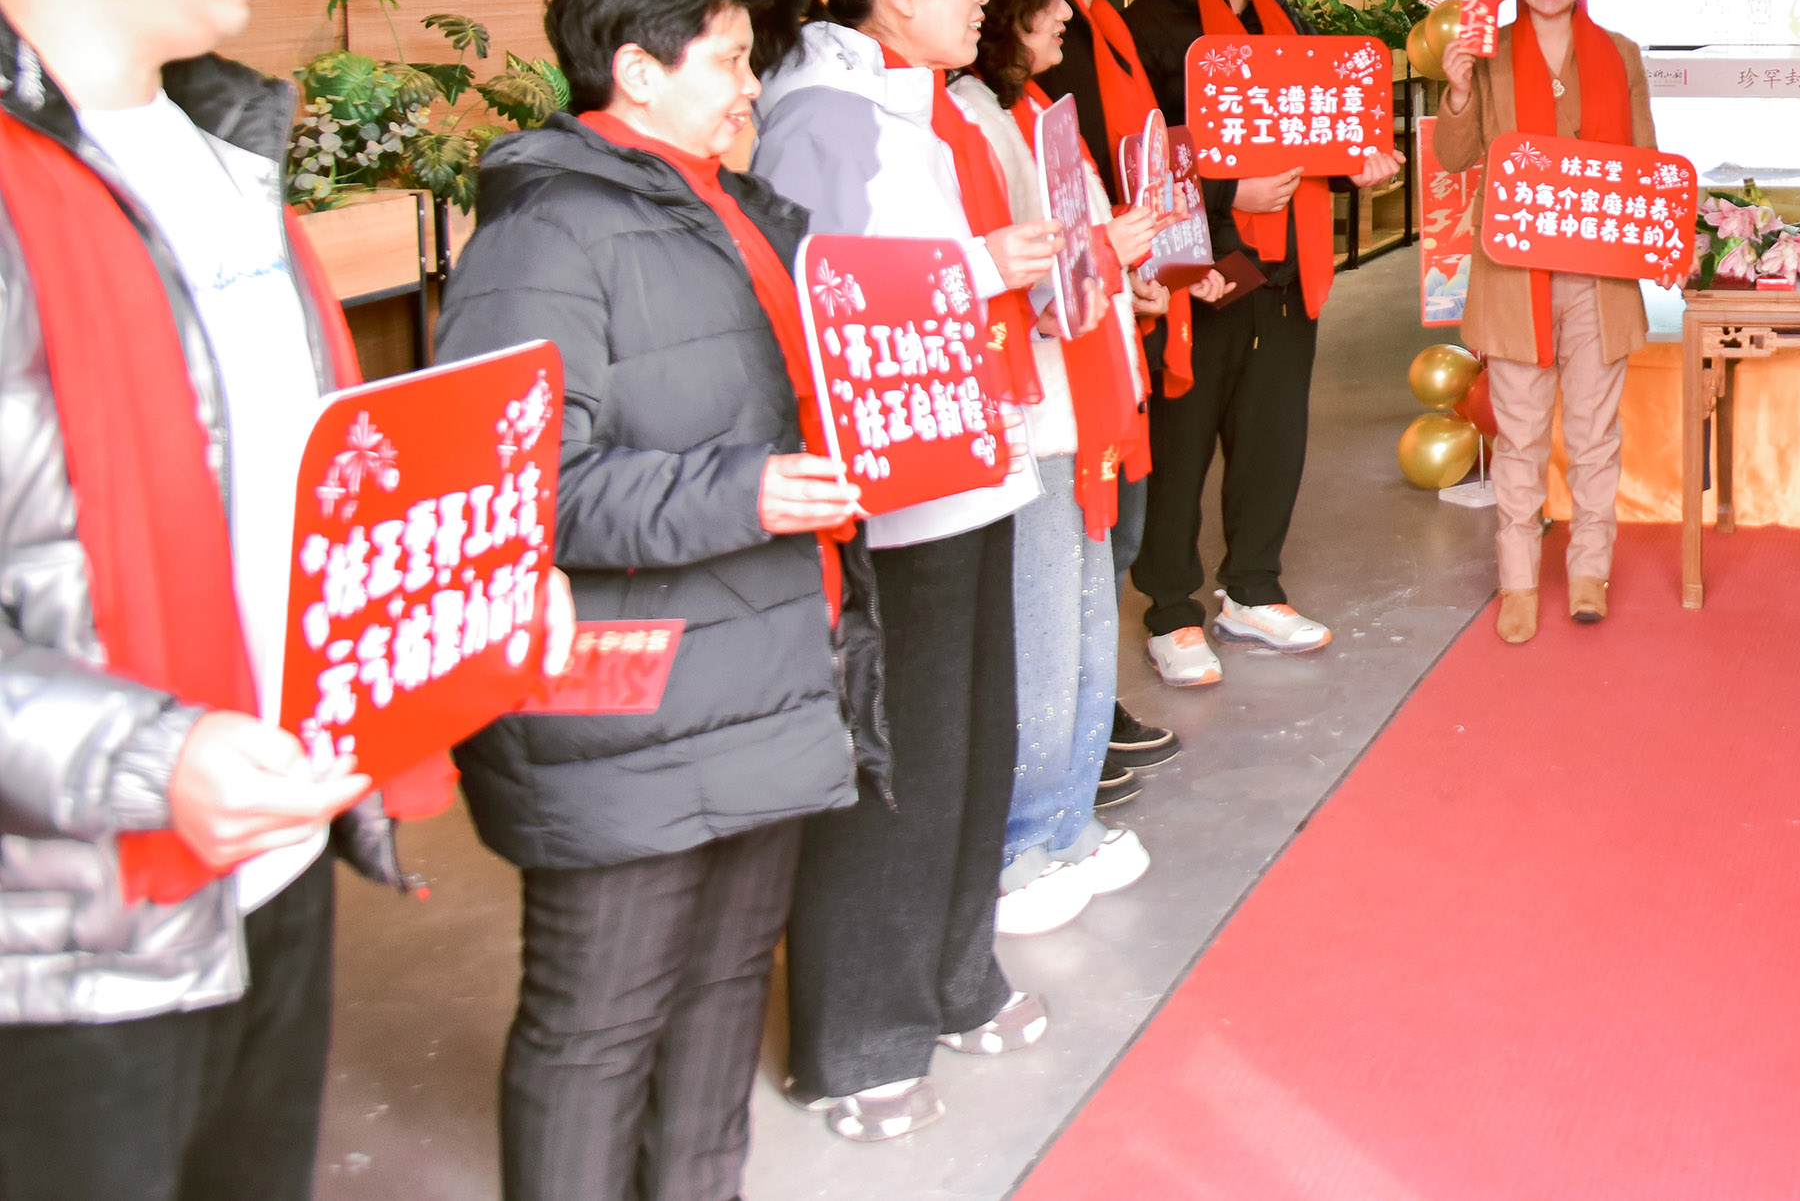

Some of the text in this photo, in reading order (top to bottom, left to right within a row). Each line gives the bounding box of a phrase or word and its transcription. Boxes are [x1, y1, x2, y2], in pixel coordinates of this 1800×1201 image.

[1218, 85, 1365, 115] 元气谱新章
[1220, 115, 1364, 145] 开工势昂扬
[1560, 155, 1623, 182] 扶正堂
[1514, 181, 1670, 222] 为每个家庭培养
[1494, 207, 1685, 250] 一个懂中医养生的人
[842, 317, 974, 380] 开工纳元气
[852, 374, 987, 450] 扶正启新程
[323, 460, 542, 618] 扶正堂开工大吉
